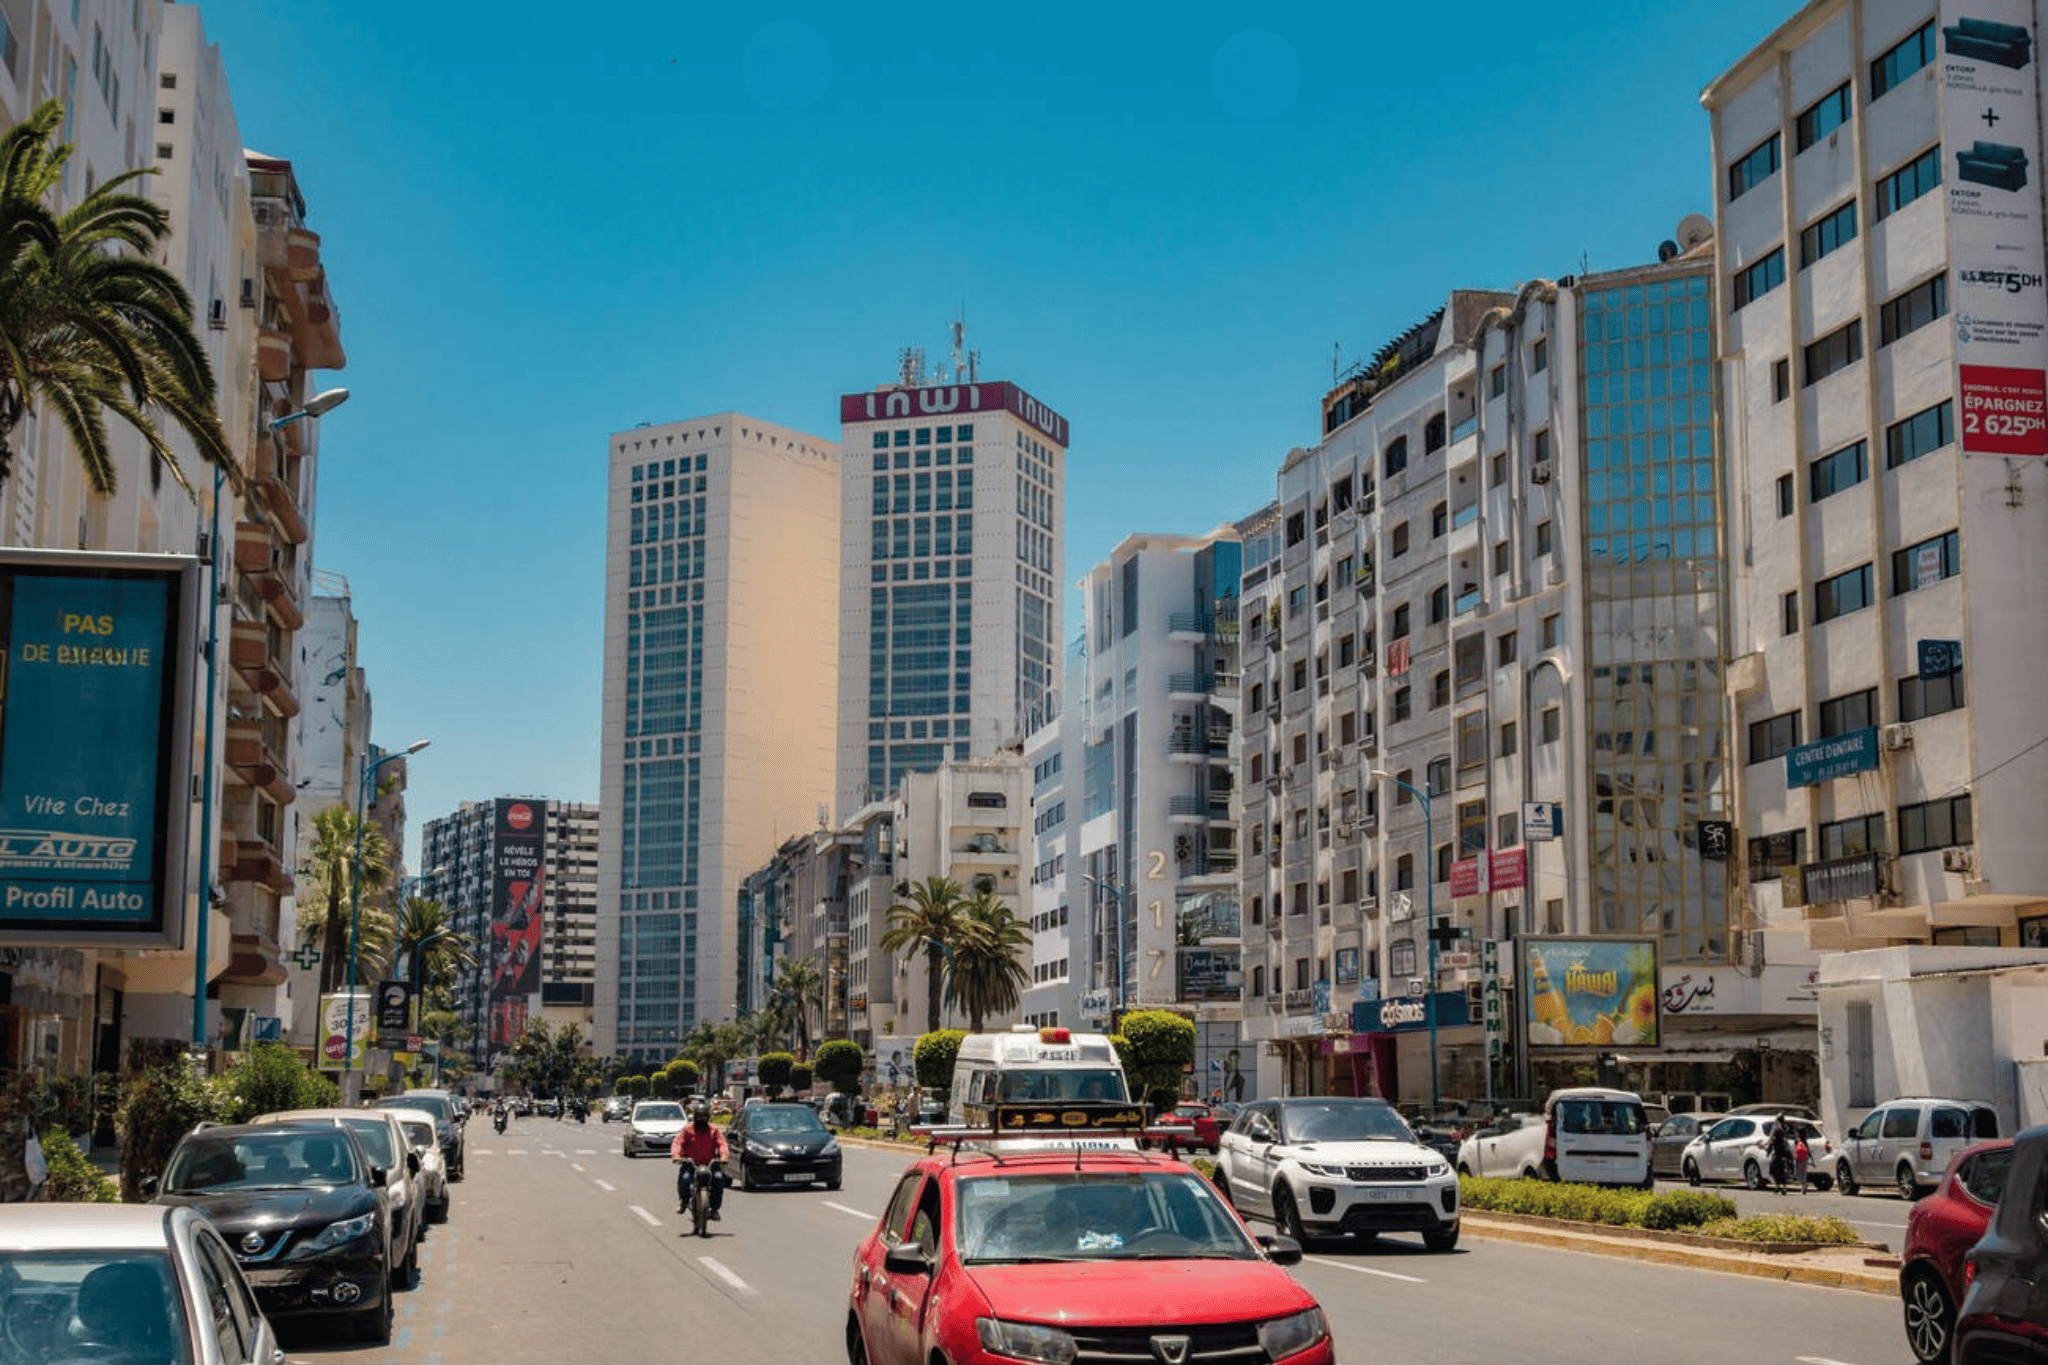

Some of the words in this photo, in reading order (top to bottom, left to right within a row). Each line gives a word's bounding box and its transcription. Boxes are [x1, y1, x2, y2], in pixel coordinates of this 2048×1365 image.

[866, 385, 980, 419] inwi
[1964, 392, 2044, 414] ÉPARGNEZ
[1018, 390, 1061, 439] inwi
[63, 613, 115, 636] PAS
[22, 643, 52, 663] DE
[25, 794, 67, 815] Vite
[74, 796, 130, 817] Chez
[29, 840, 137, 859] AUTO
[6, 886, 75, 909] Profil
[81, 888, 144, 911] Auto
